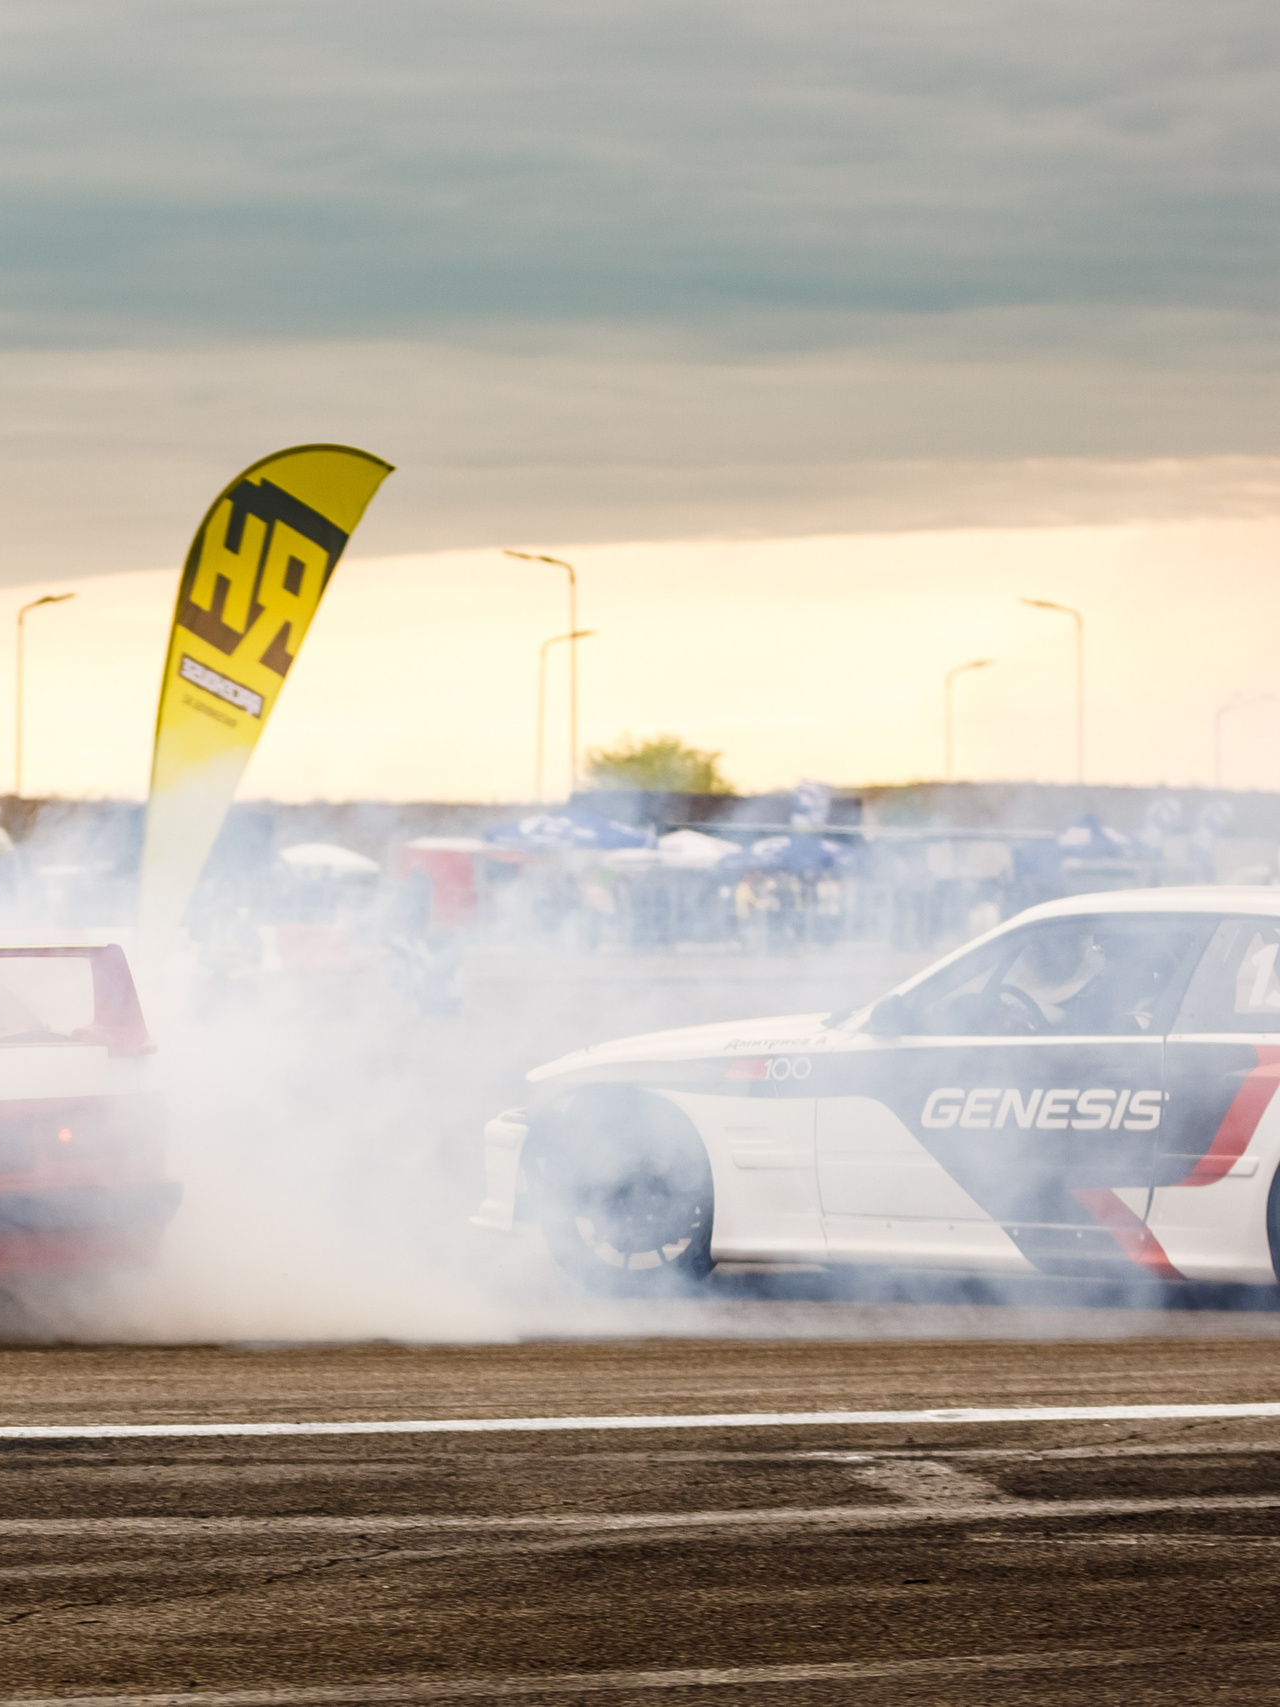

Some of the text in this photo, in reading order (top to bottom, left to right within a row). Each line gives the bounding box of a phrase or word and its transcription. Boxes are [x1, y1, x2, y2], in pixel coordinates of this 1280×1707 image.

[1248, 943, 1280, 1008] 1
[764, 1057, 812, 1080] 100
[921, 1087, 1170, 1130] GENESIS
